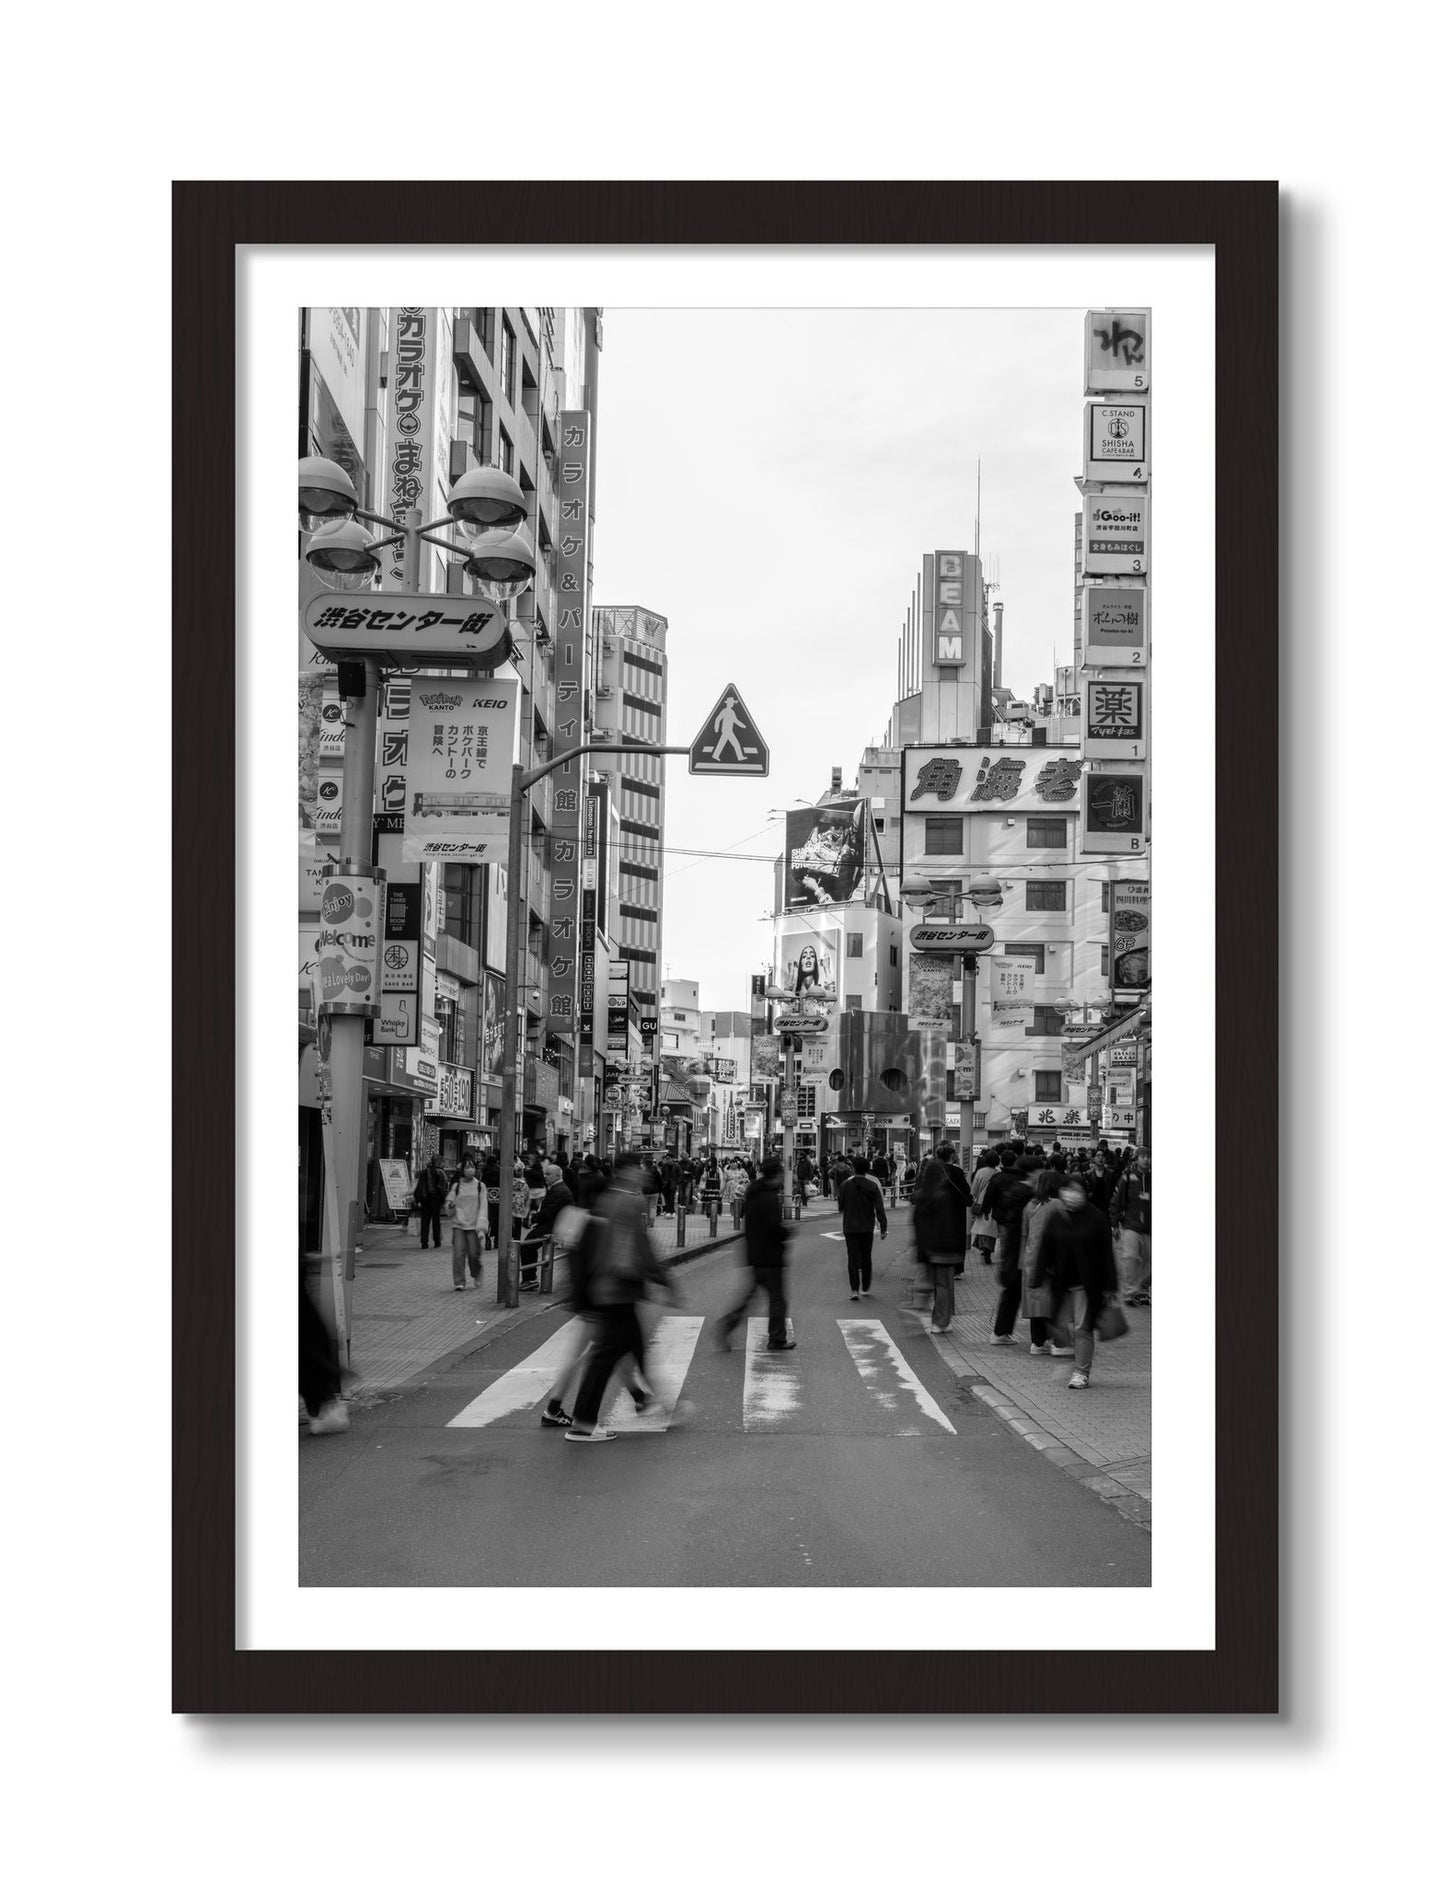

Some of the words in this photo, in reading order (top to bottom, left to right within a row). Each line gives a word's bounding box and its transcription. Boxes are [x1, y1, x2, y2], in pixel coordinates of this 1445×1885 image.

[395, 314, 426, 414] カラオケ
[1134, 375, 1143, 387] 5
[1102, 440, 1135, 448] SHISHA
[1101, 510, 1141, 522] Goo-it!
[1092, 543, 1142, 551] 全身もみほぐし
[1132, 559, 1142, 572] 3
[938, 554, 963, 660] BEAM
[313, 607, 495, 634] 渋谷センター街
[1132, 651, 1141, 664] 2
[472, 698, 508, 709] KEIO
[1095, 687, 1132, 724] 薬
[445, 725, 458, 779] カントーの
[476, 725, 488, 769] 京王線で
[1132, 744, 1138, 757] 1
[910, 756, 1083, 801] 角海老
[423, 843, 487, 852] 渋谷センター街
[1131, 838, 1140, 850] B
[322, 893, 352, 918] Enjoy
[550, 841, 576, 1017] カラオケ館
[914, 930, 990, 940] 渋谷センター街
[320, 929, 376, 948] Welcome
[1114, 936, 1137, 952] 6F
[381, 1019, 406, 1028] Whisky
[641, 1021, 657, 1030] GU
